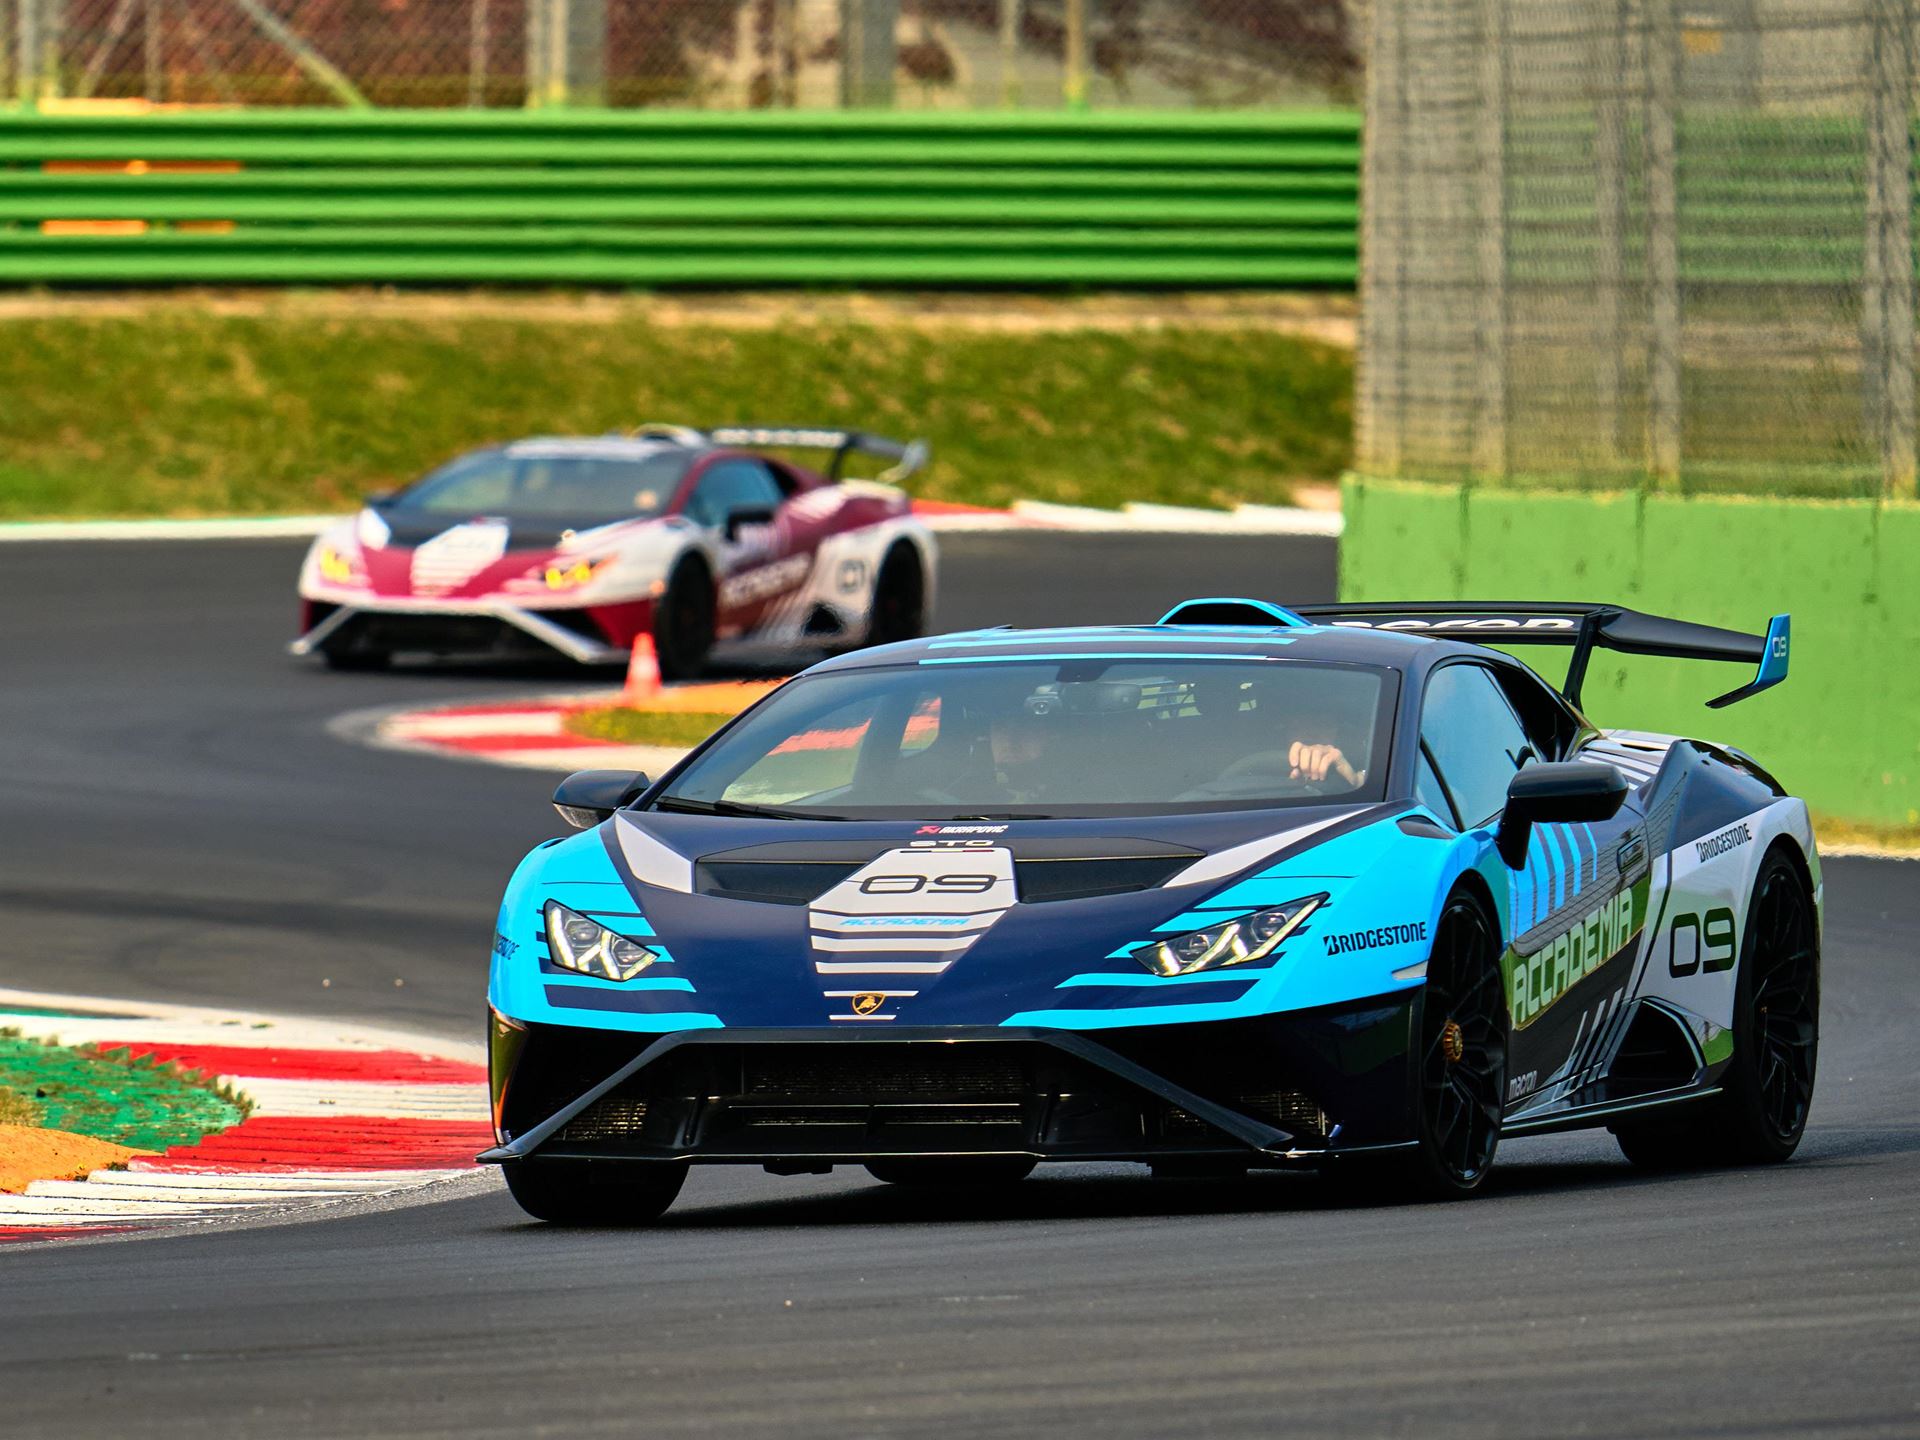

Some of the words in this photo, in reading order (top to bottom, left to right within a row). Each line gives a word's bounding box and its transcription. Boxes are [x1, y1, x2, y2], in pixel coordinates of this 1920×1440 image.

[1773, 637, 1786, 657] 09
[1695, 823, 1753, 863] BRIDGESTONE
[859, 874, 997, 895] 09
[1323, 921, 1427, 956] BRIDGESTONE
[1669, 906, 1736, 978] 09
[1511, 887, 1633, 1030] ACCADEMIA
[1508, 1070, 1537, 1100] macron
